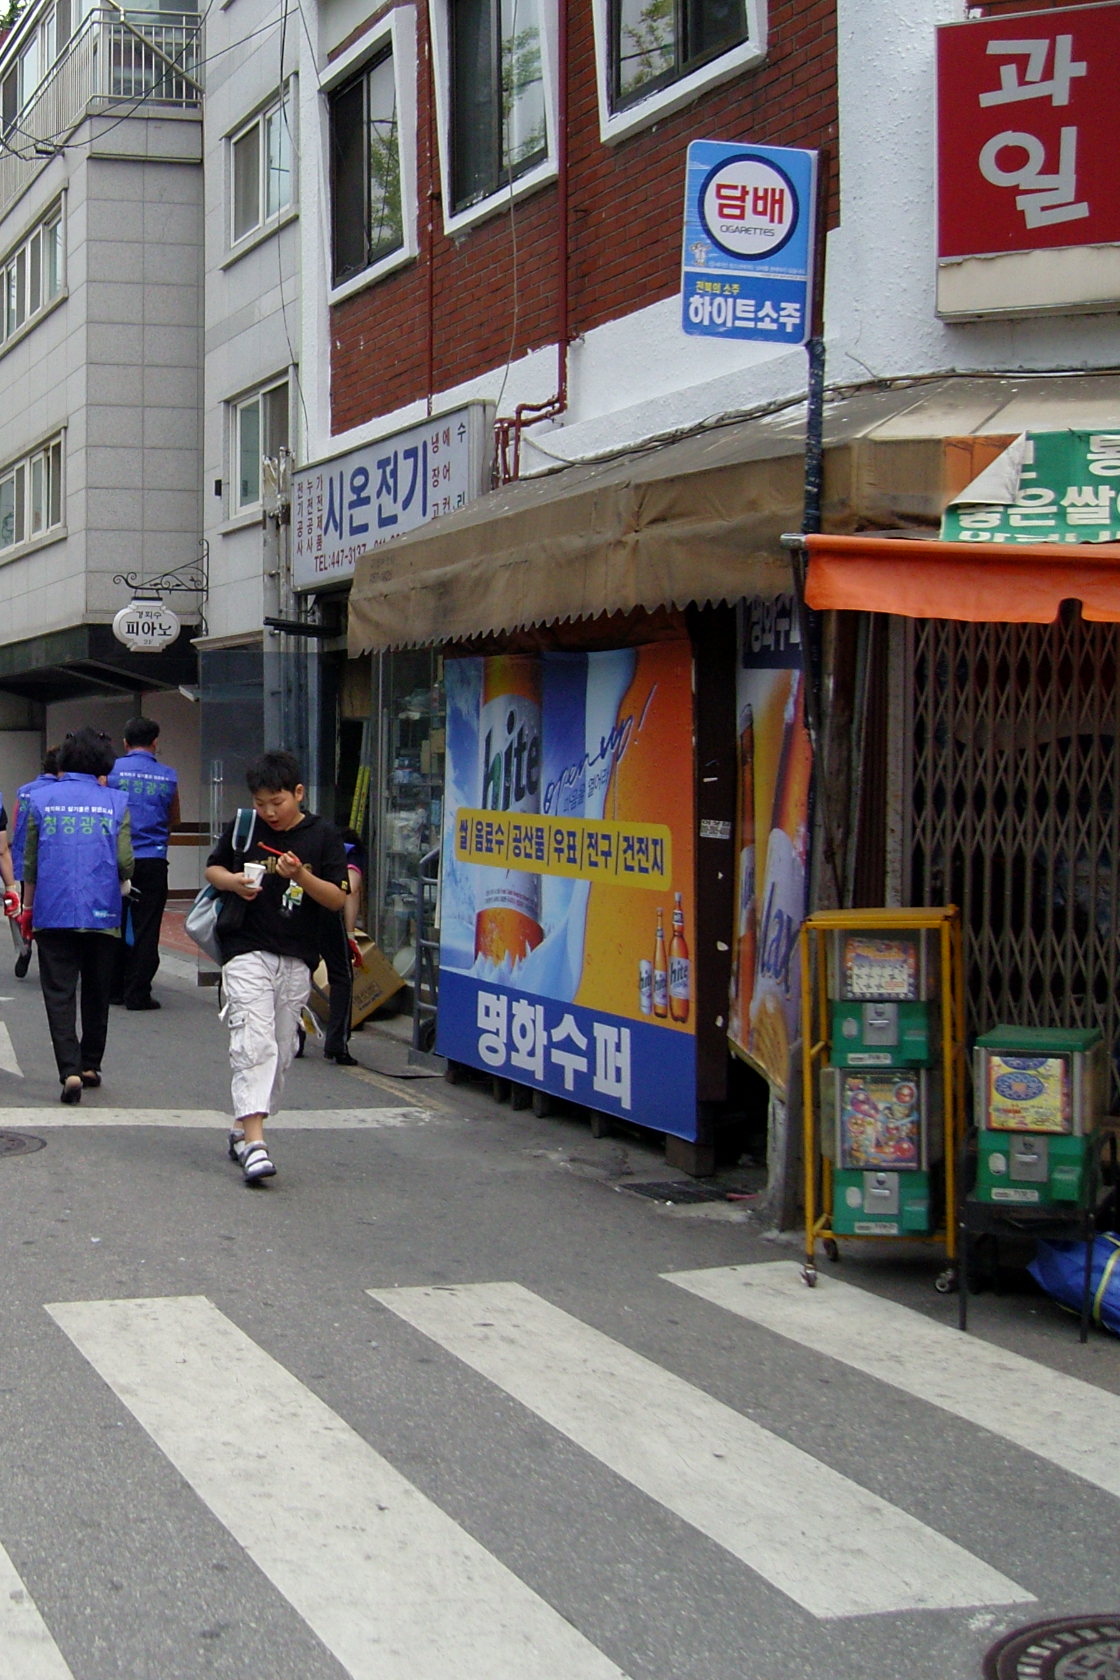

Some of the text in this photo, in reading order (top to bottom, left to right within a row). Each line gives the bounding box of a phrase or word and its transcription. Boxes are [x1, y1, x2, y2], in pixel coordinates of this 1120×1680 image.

[979, 34, 1089, 230] 과일
[715, 182, 785, 225] 담배
[719, 224, 775, 237] CIGARETTES
[723, 282, 740, 295] 소주
[688, 294, 801, 332] 하이트소주
[323, 440, 428, 541] 시온전기
[125, 621, 172, 637] 피아노
[481, 710, 542, 811] hite
[44, 816, 113, 836] 청정광진
[458, 818, 664, 876] 쌀 음료수 공산품 우표 전구 건전지
[476, 990, 631, 1110] 명화수퍼
